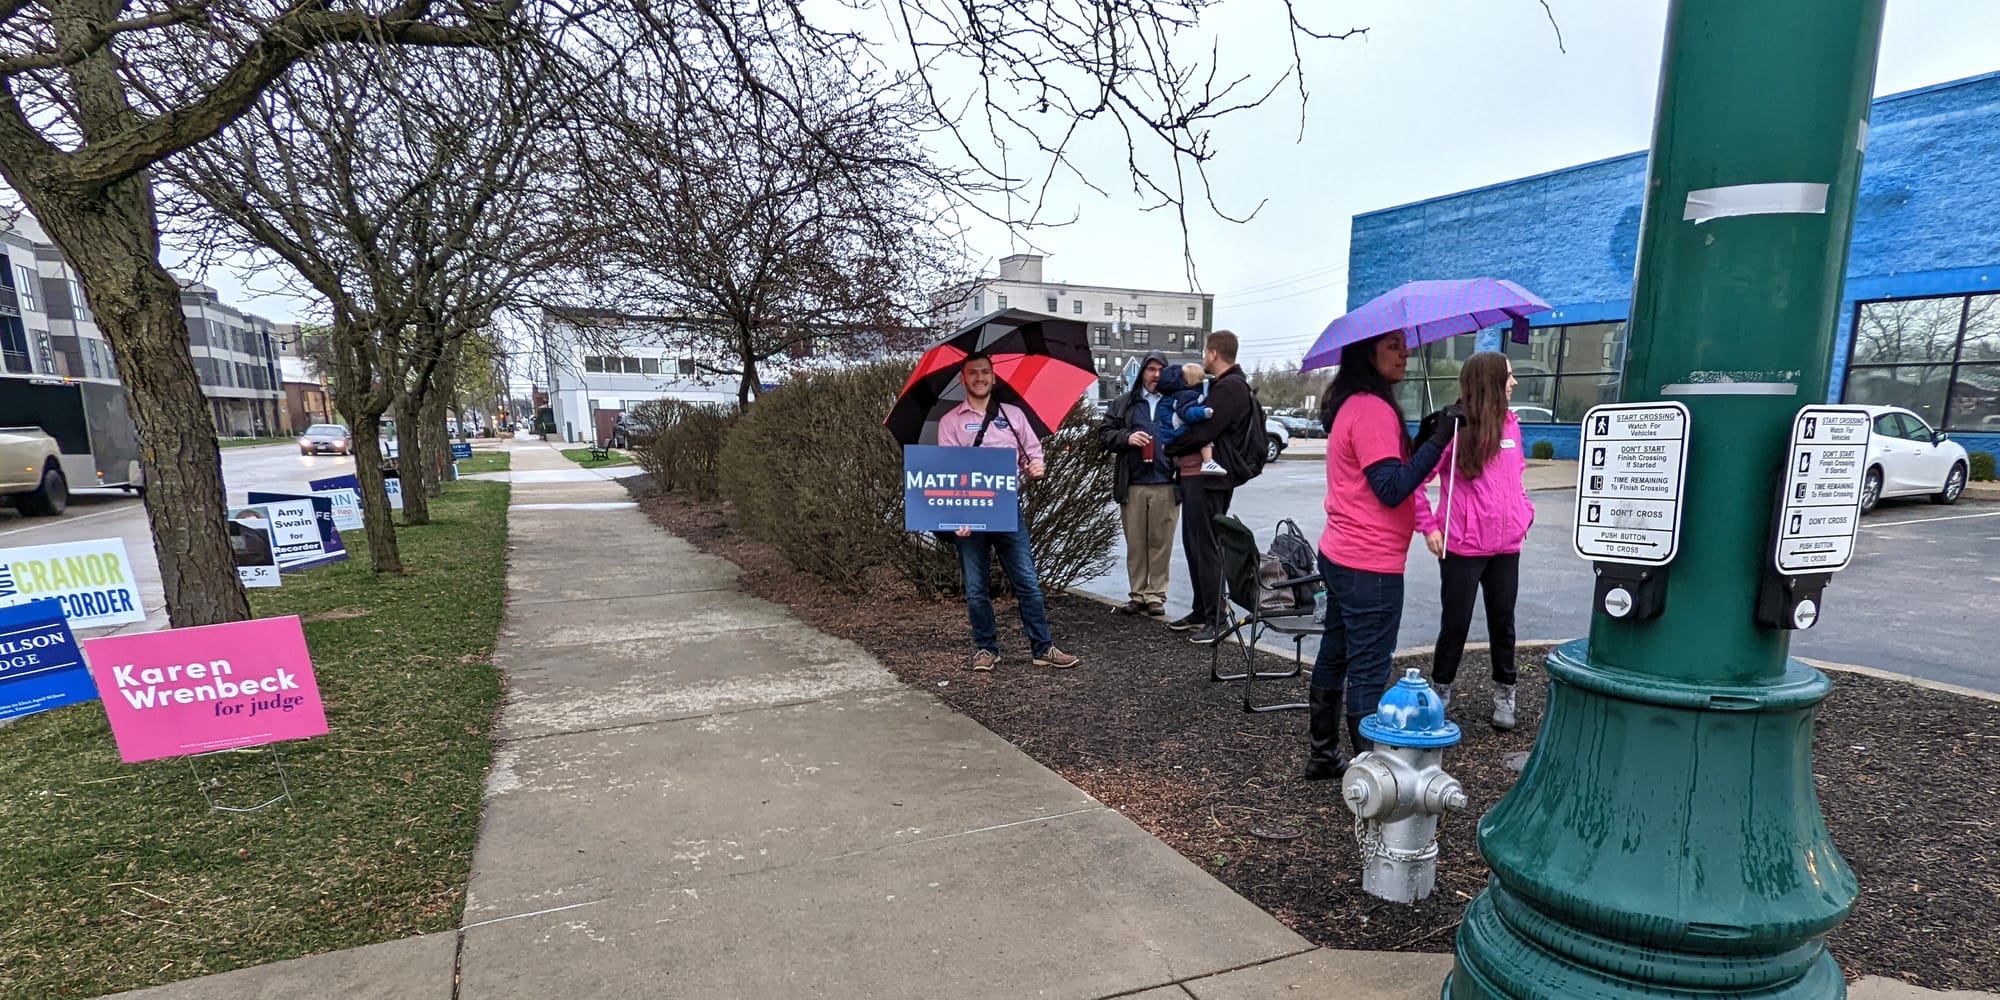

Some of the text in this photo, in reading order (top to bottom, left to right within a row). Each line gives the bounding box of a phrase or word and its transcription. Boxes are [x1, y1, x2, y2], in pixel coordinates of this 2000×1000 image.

[1639, 412, 1675, 420] CROSSING
[906, 470, 1017, 491] MATT FYFE
[1640, 485, 1669, 493] Crossing
[928, 498, 994, 507] CONGRESS
[277, 508, 304, 518] Amy
[1610, 509, 1663, 519] DON'T CROSS
[274, 518, 313, 529] Swain
[1808, 517, 1827, 525] DON'T
[1600, 531, 1647, 541] PUSH BUTTON
[273, 543, 320, 554] Recorder
[1616, 545, 1639, 553] CROSS
[11, 552, 125, 594] CRANOR
[254, 568, 268, 577] Sr.
[31, 589, 134, 618] CORDER
[112, 658, 233, 688] Karen
[120, 667, 299, 710] Wrenbeck
[214, 693, 304, 717] for judge
